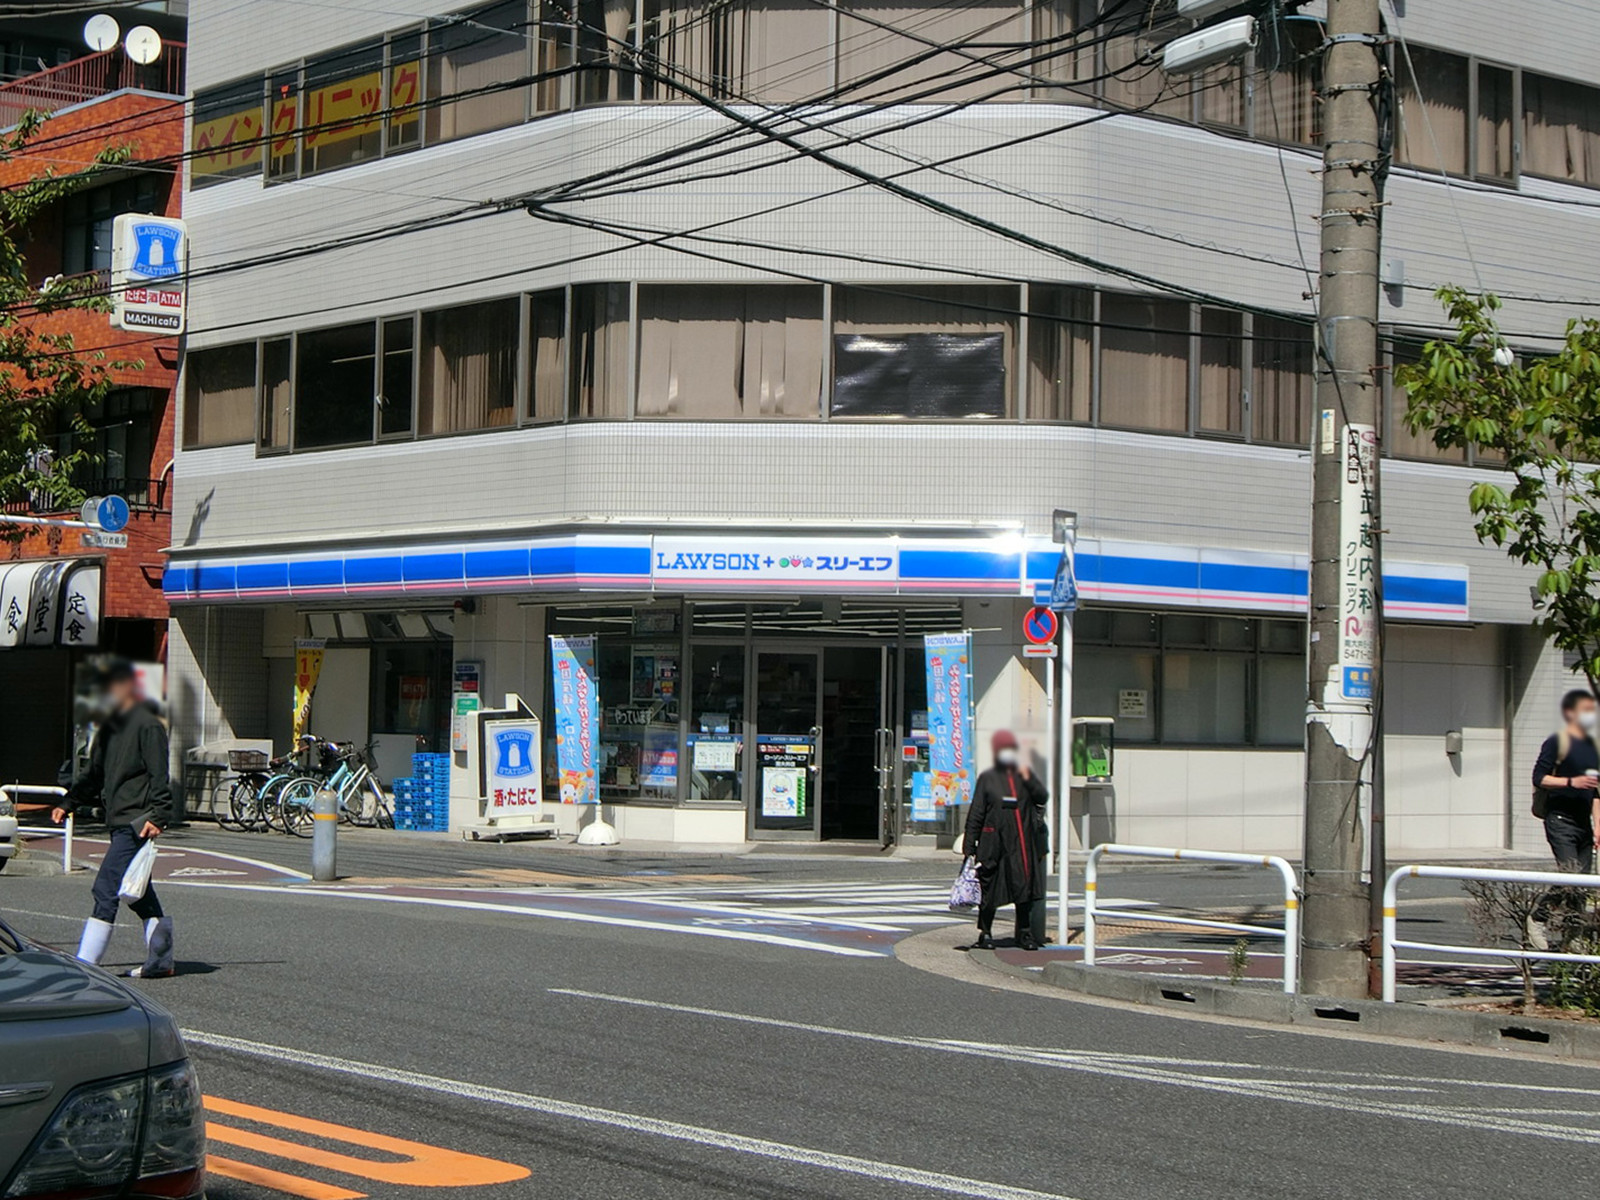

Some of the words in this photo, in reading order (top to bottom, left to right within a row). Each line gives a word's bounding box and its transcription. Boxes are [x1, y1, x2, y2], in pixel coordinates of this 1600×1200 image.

[196, 68, 417, 165] ペインクリニック
[137, 226, 178, 240] LAWSON
[136, 262, 176, 276] STATION
[161, 292, 181, 306] ATM
[126, 313, 158, 326] MACHI
[158, 315, 178, 327] café
[657, 553, 760, 571] LAWSON
[816, 556, 893, 571] スリーエフ
[1345, 541, 1357, 614] クリニック
[65, 592, 86, 642] 定食
[615, 708, 652, 725] やっています
[497, 732, 531, 742] LAWSON
[499, 766, 532, 776] STATION
[494, 788, 537, 807] 酒・たばこ
